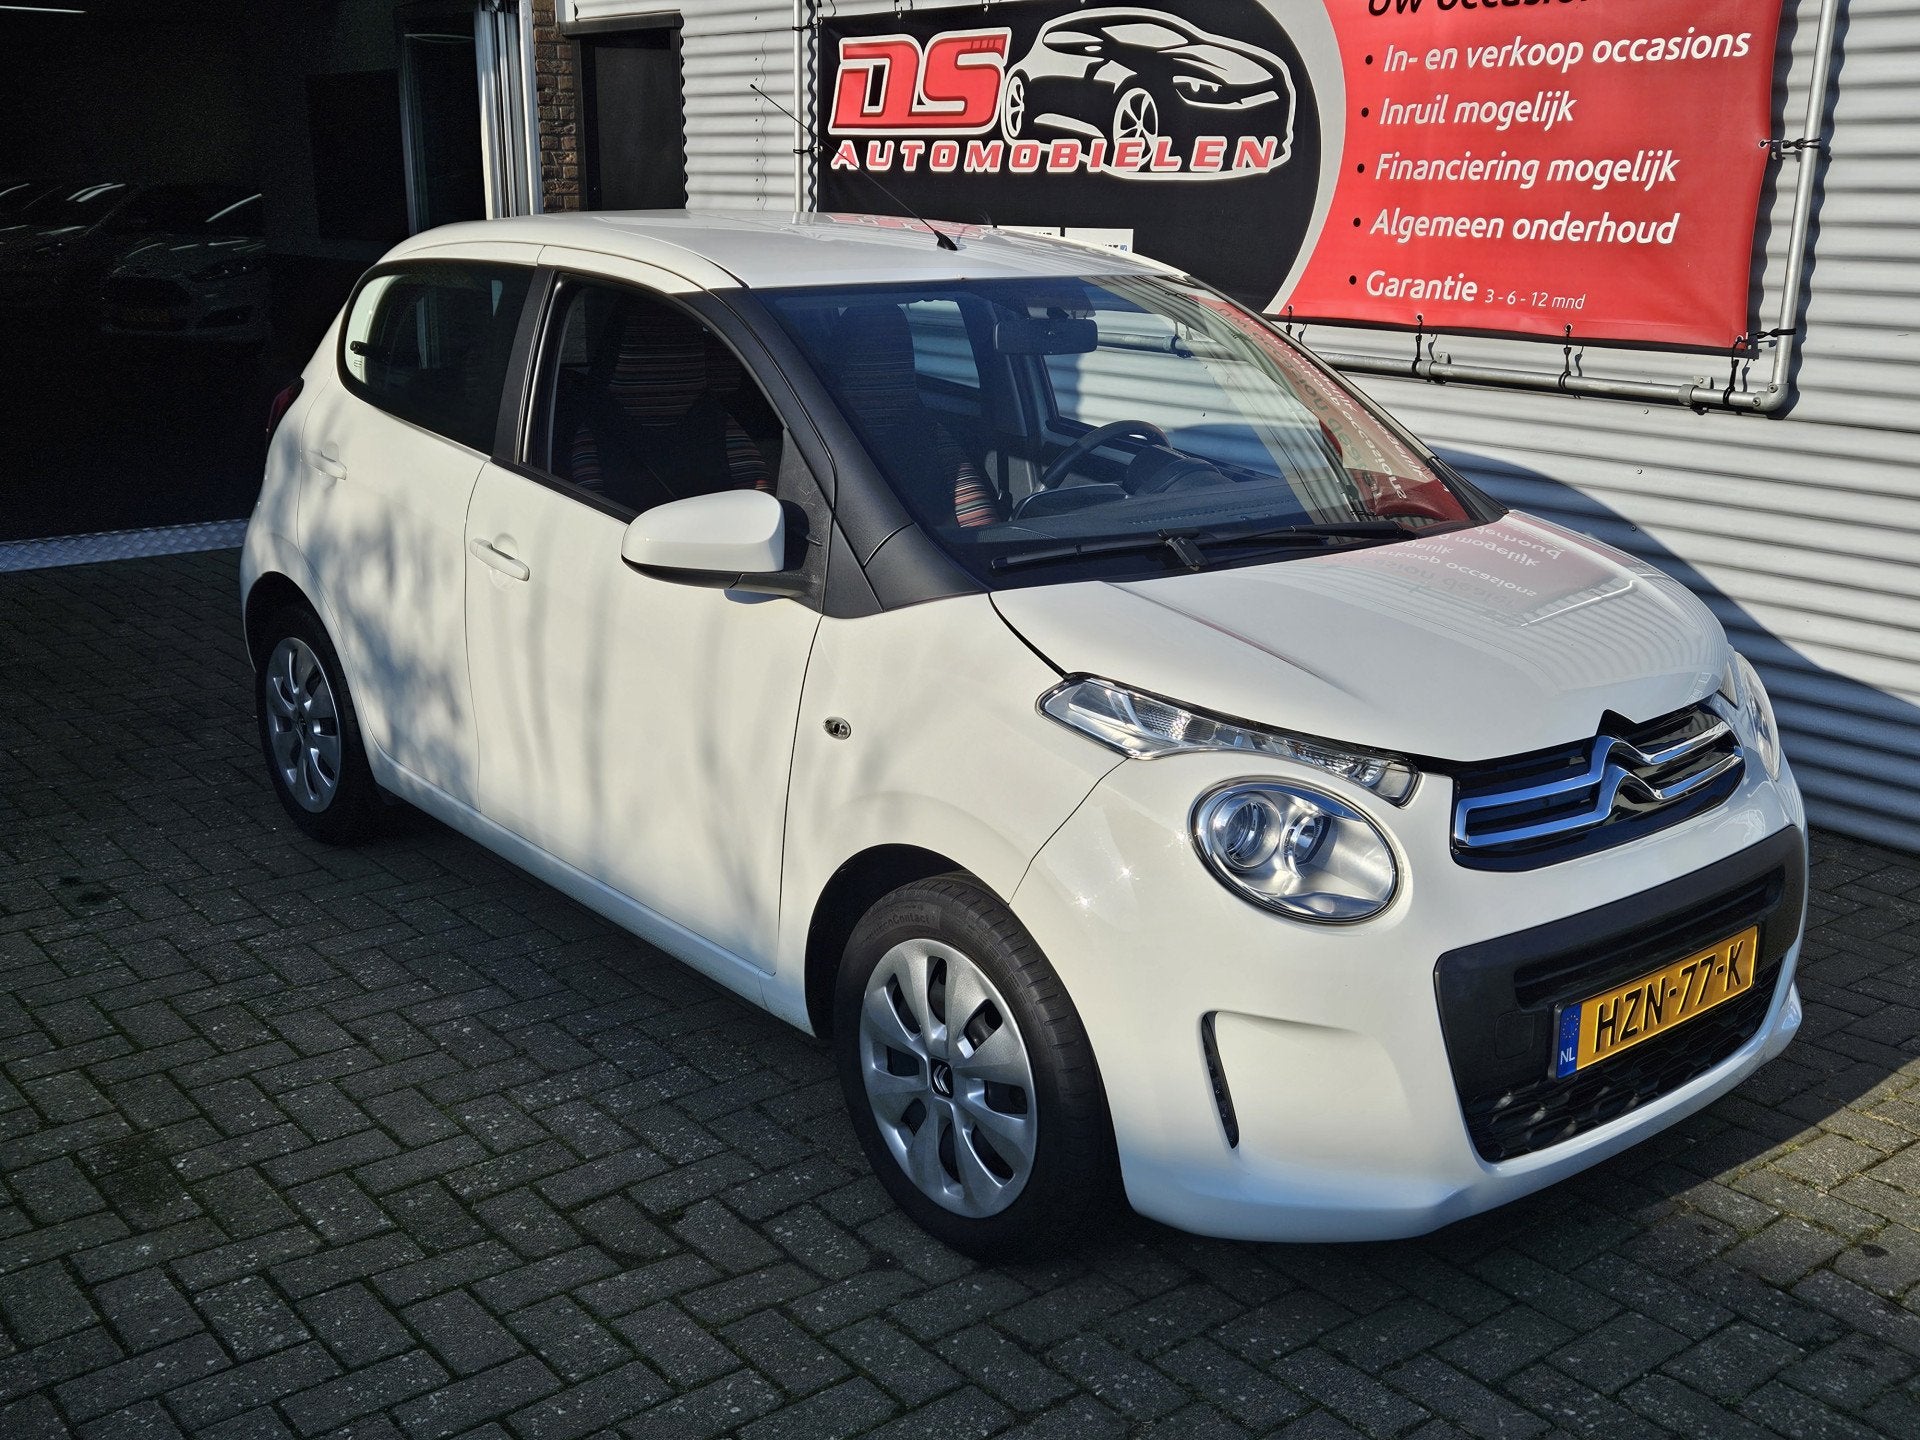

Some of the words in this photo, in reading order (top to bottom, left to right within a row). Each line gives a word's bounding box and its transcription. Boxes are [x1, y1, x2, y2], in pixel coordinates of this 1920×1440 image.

[1383, 44, 1418, 73] In-
[1425, 47, 1458, 70] en
[1467, 35, 1584, 74] verkoop
[1592, 26, 1752, 64] occasions
[828, 27, 1012, 135] DS
[1379, 93, 1449, 125] Inruil
[1453, 90, 1578, 132] mogelijk
[831, 136, 1278, 174] AUTOMOBIELEN
[1375, 150, 1540, 190] Financiering
[1546, 149, 1681, 192] mogelijk
[1369, 207, 1505, 244] Algemeen
[1512, 211, 1681, 245] onderhoud
[1366, 269, 1478, 302] Garantie
[1484, 288, 1495, 304] 3
[1506, 290, 1516, 305] 6
[1531, 291, 1549, 307] 12
[1551, 293, 1586, 310] mnd
[1593, 940, 1745, 1054] HZN-77-K
[1559, 1047, 1576, 1066] NL
